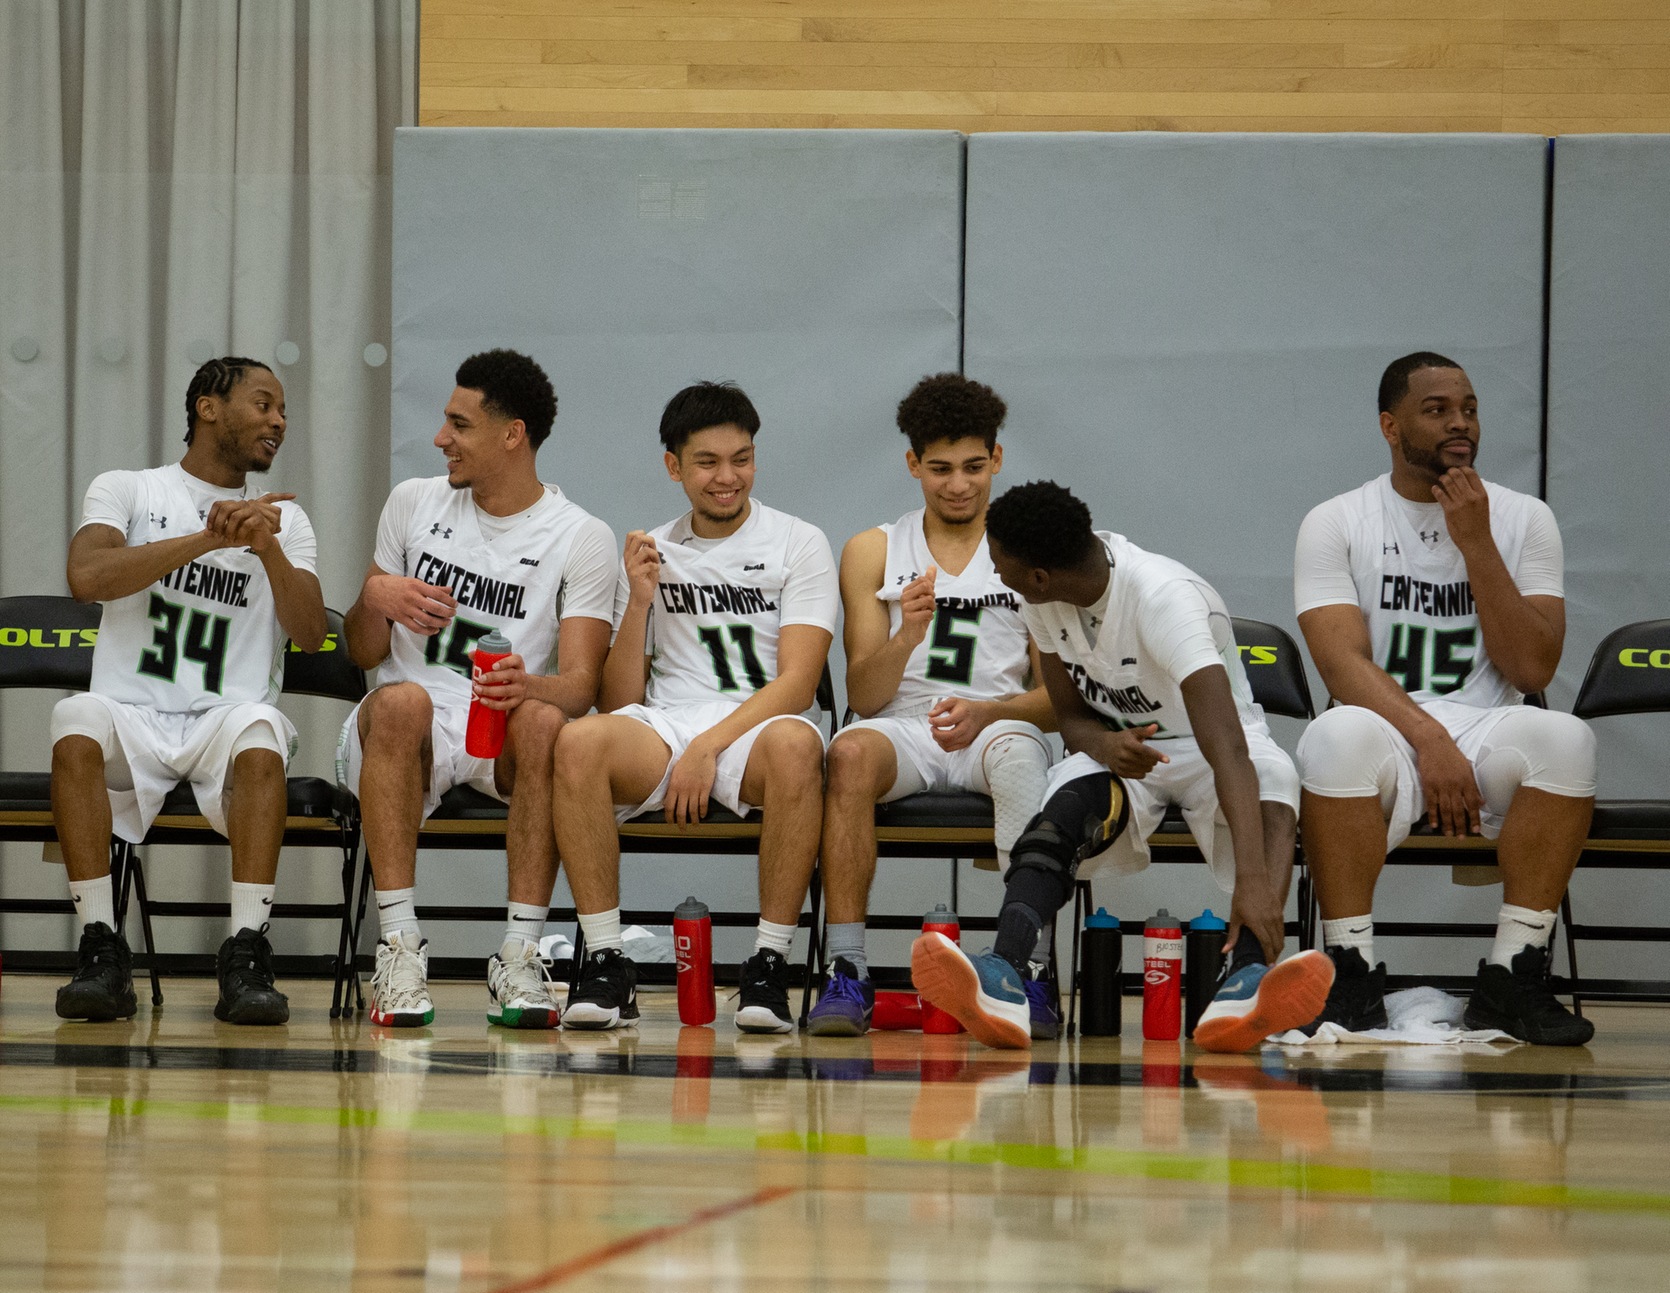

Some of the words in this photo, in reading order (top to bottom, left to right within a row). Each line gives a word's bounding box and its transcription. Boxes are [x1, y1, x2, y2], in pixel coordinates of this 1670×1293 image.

[159, 559, 252, 608] TENNIAL
[414, 551, 527, 620] CENTENNIAL
[657, 581, 778, 616] CENTENNIAL
[1380, 574, 1478, 617] CENTENNIA
[136, 591, 232, 697] 34
[697, 623, 768, 693] 11
[925, 604, 983, 687] 5
[1385, 623, 1476, 695] 45
